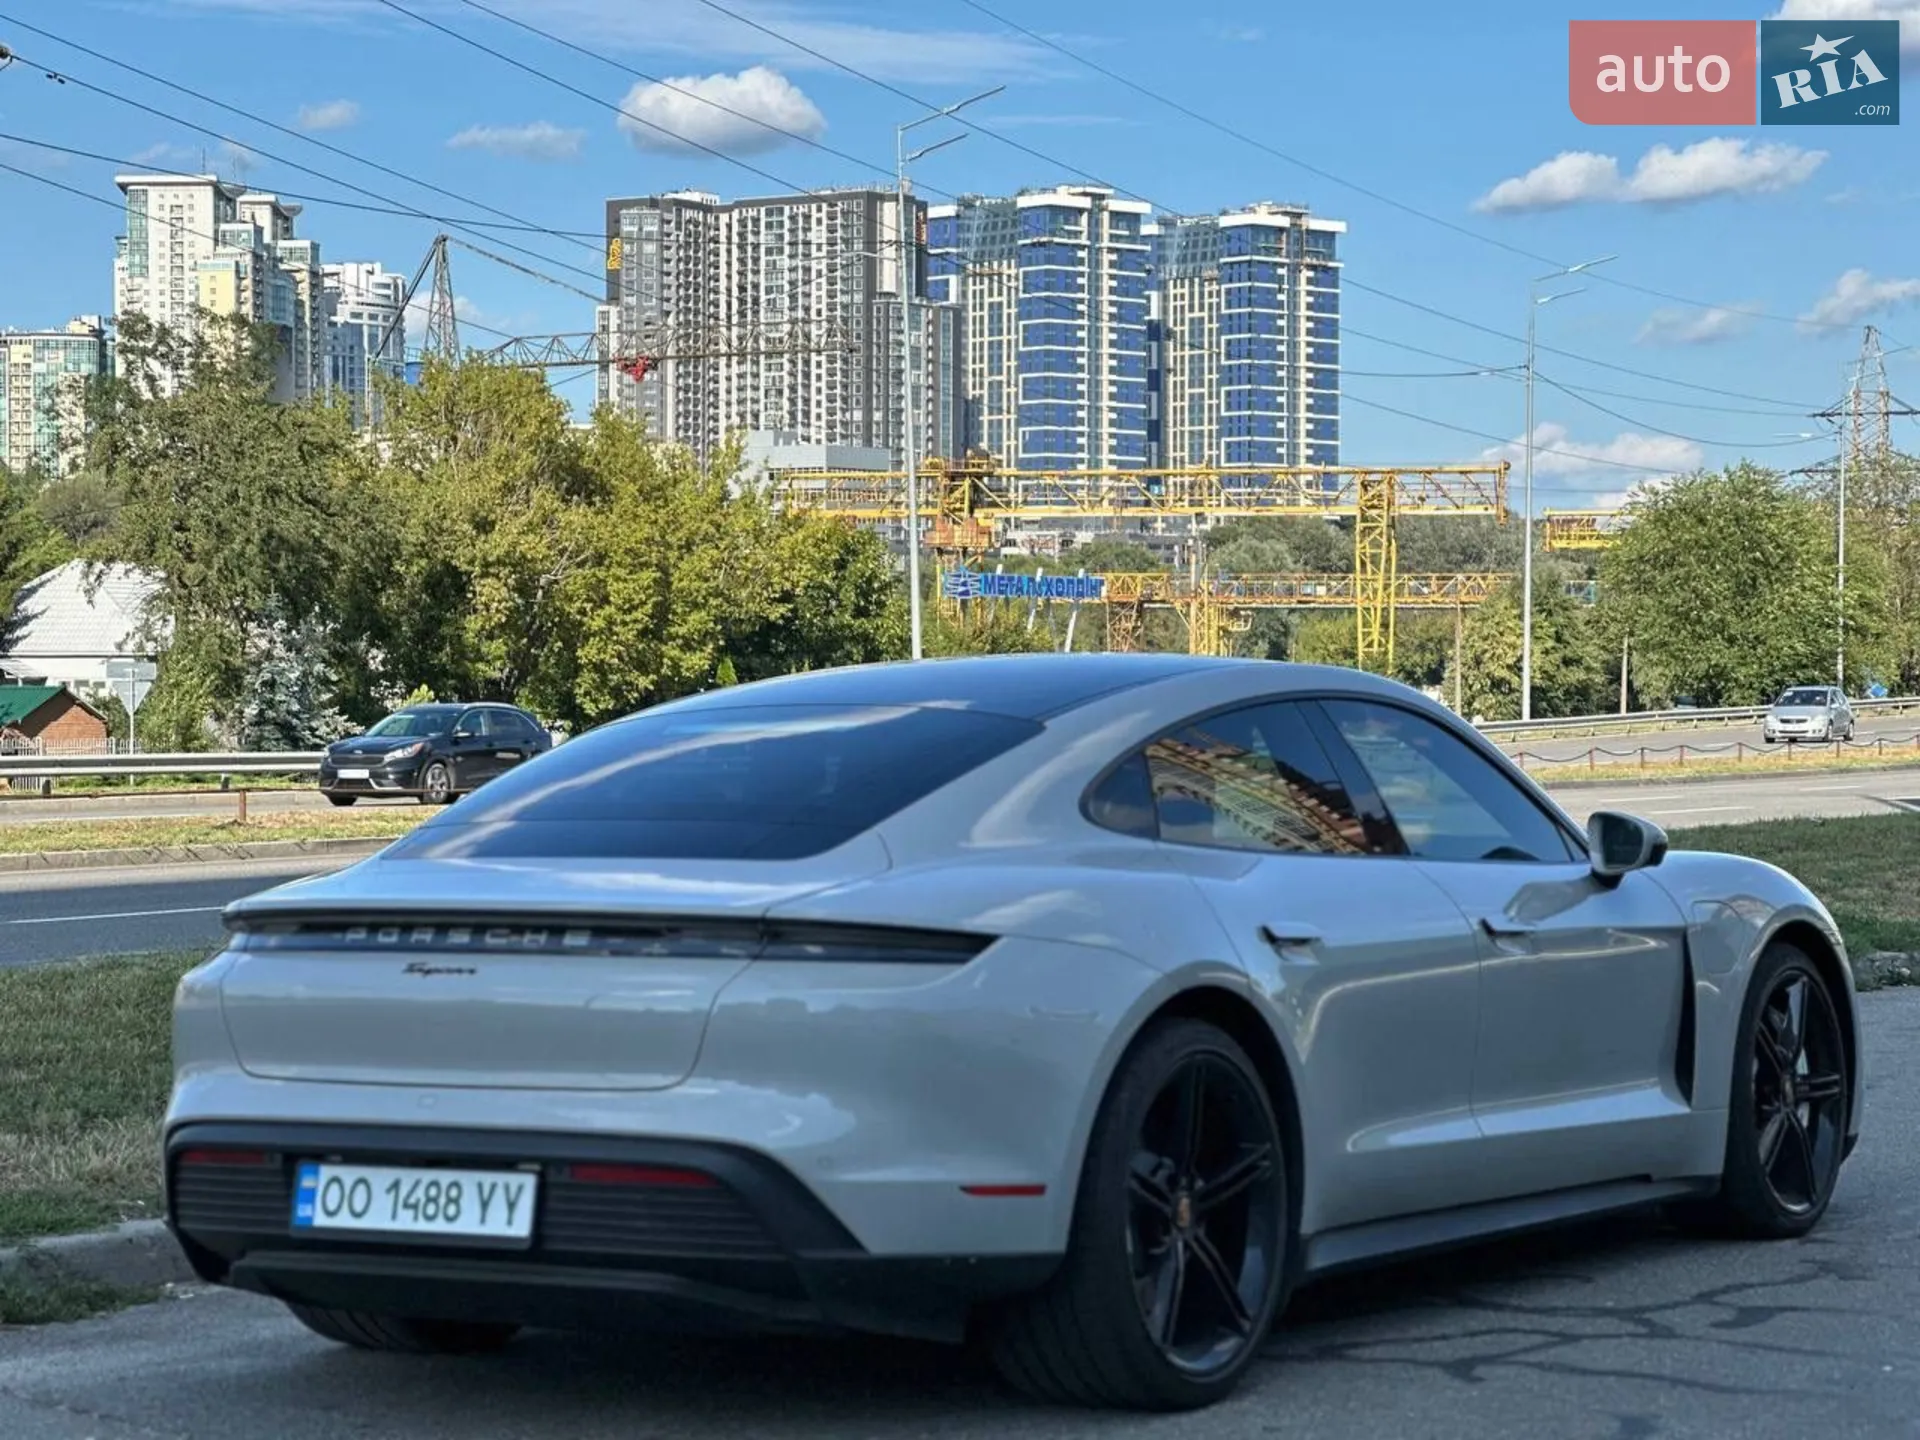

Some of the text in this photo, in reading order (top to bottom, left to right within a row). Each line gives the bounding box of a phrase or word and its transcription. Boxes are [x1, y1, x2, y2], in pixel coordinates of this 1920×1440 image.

[344, 927, 592, 947] PORSCHE
[321, 1175, 525, 1227] OO 1488 YY
